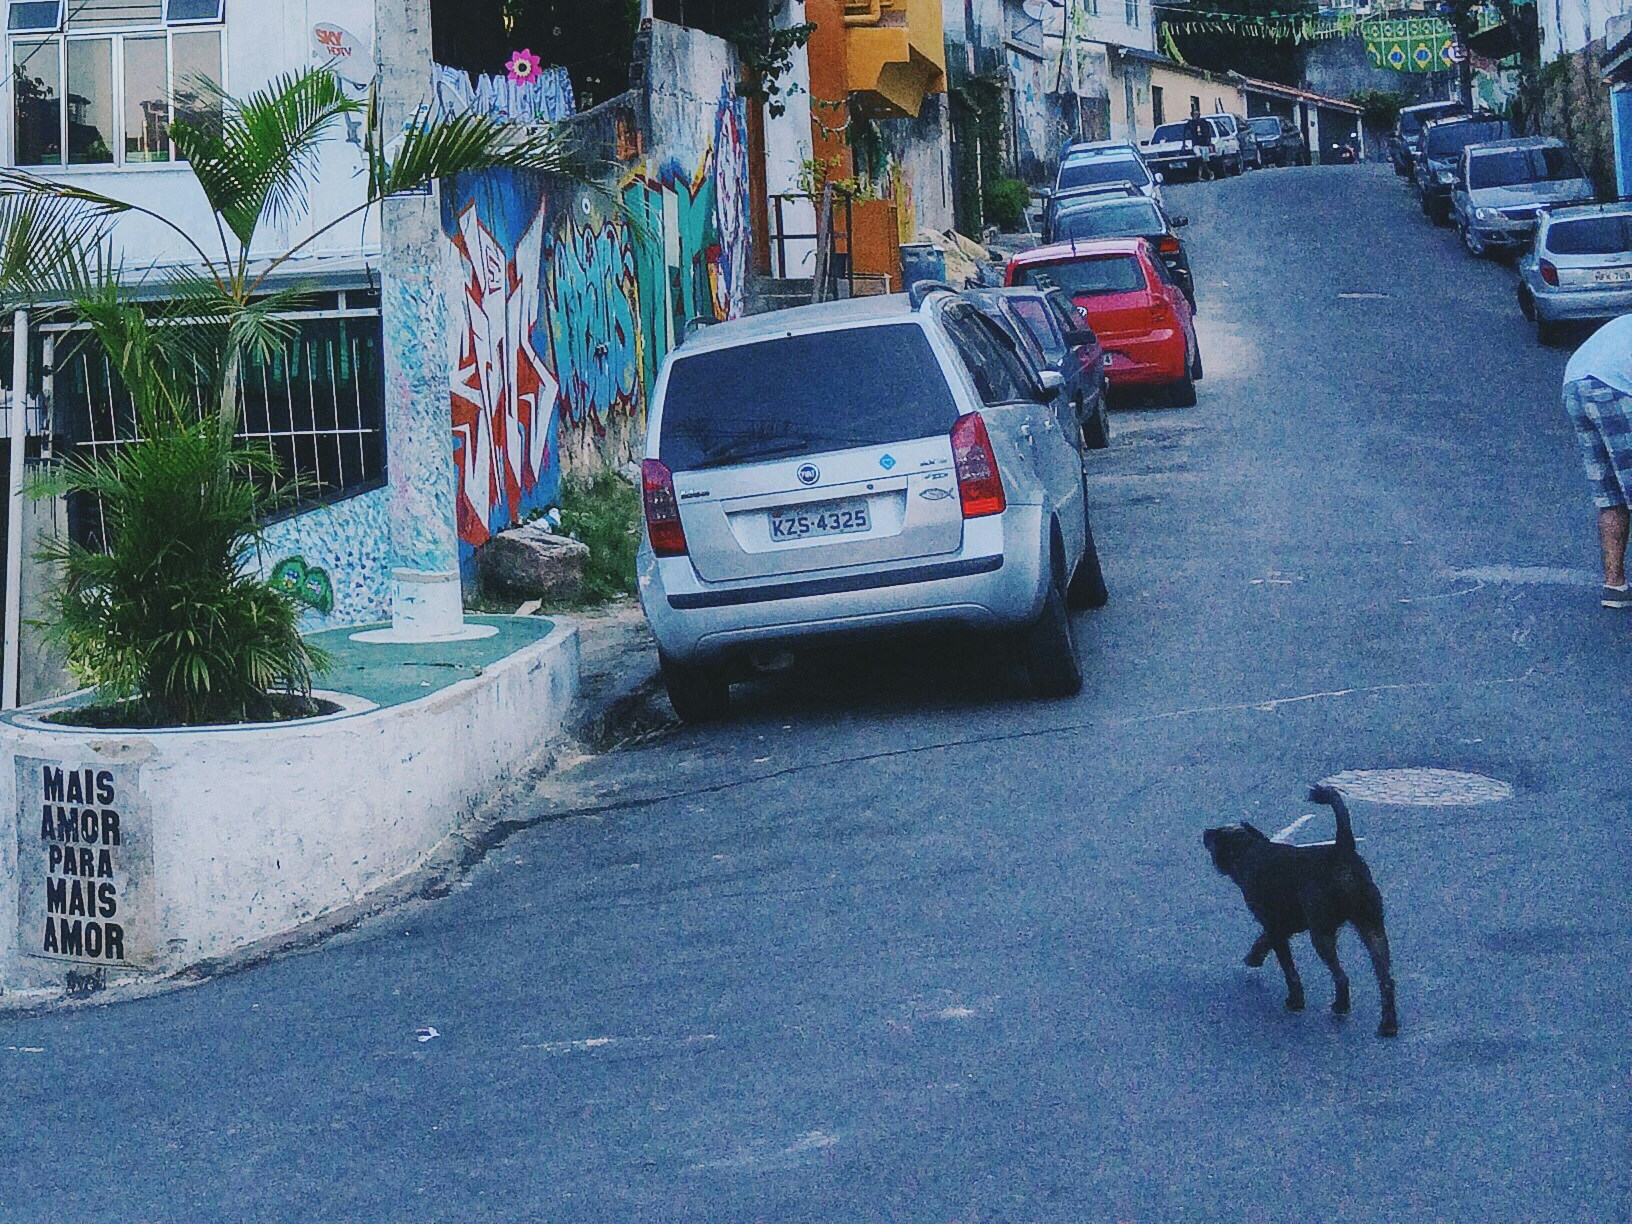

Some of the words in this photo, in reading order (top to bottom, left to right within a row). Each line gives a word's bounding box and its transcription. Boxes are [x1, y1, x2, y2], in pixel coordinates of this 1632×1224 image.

[315, 28, 344, 47] SKY
[43, 765, 115, 805] MAIS
[41, 805, 121, 846] AMOR
[49, 844, 114, 878] PARA
[47, 877, 117, 918] MAIS
[43, 917, 125, 960] AMOR
